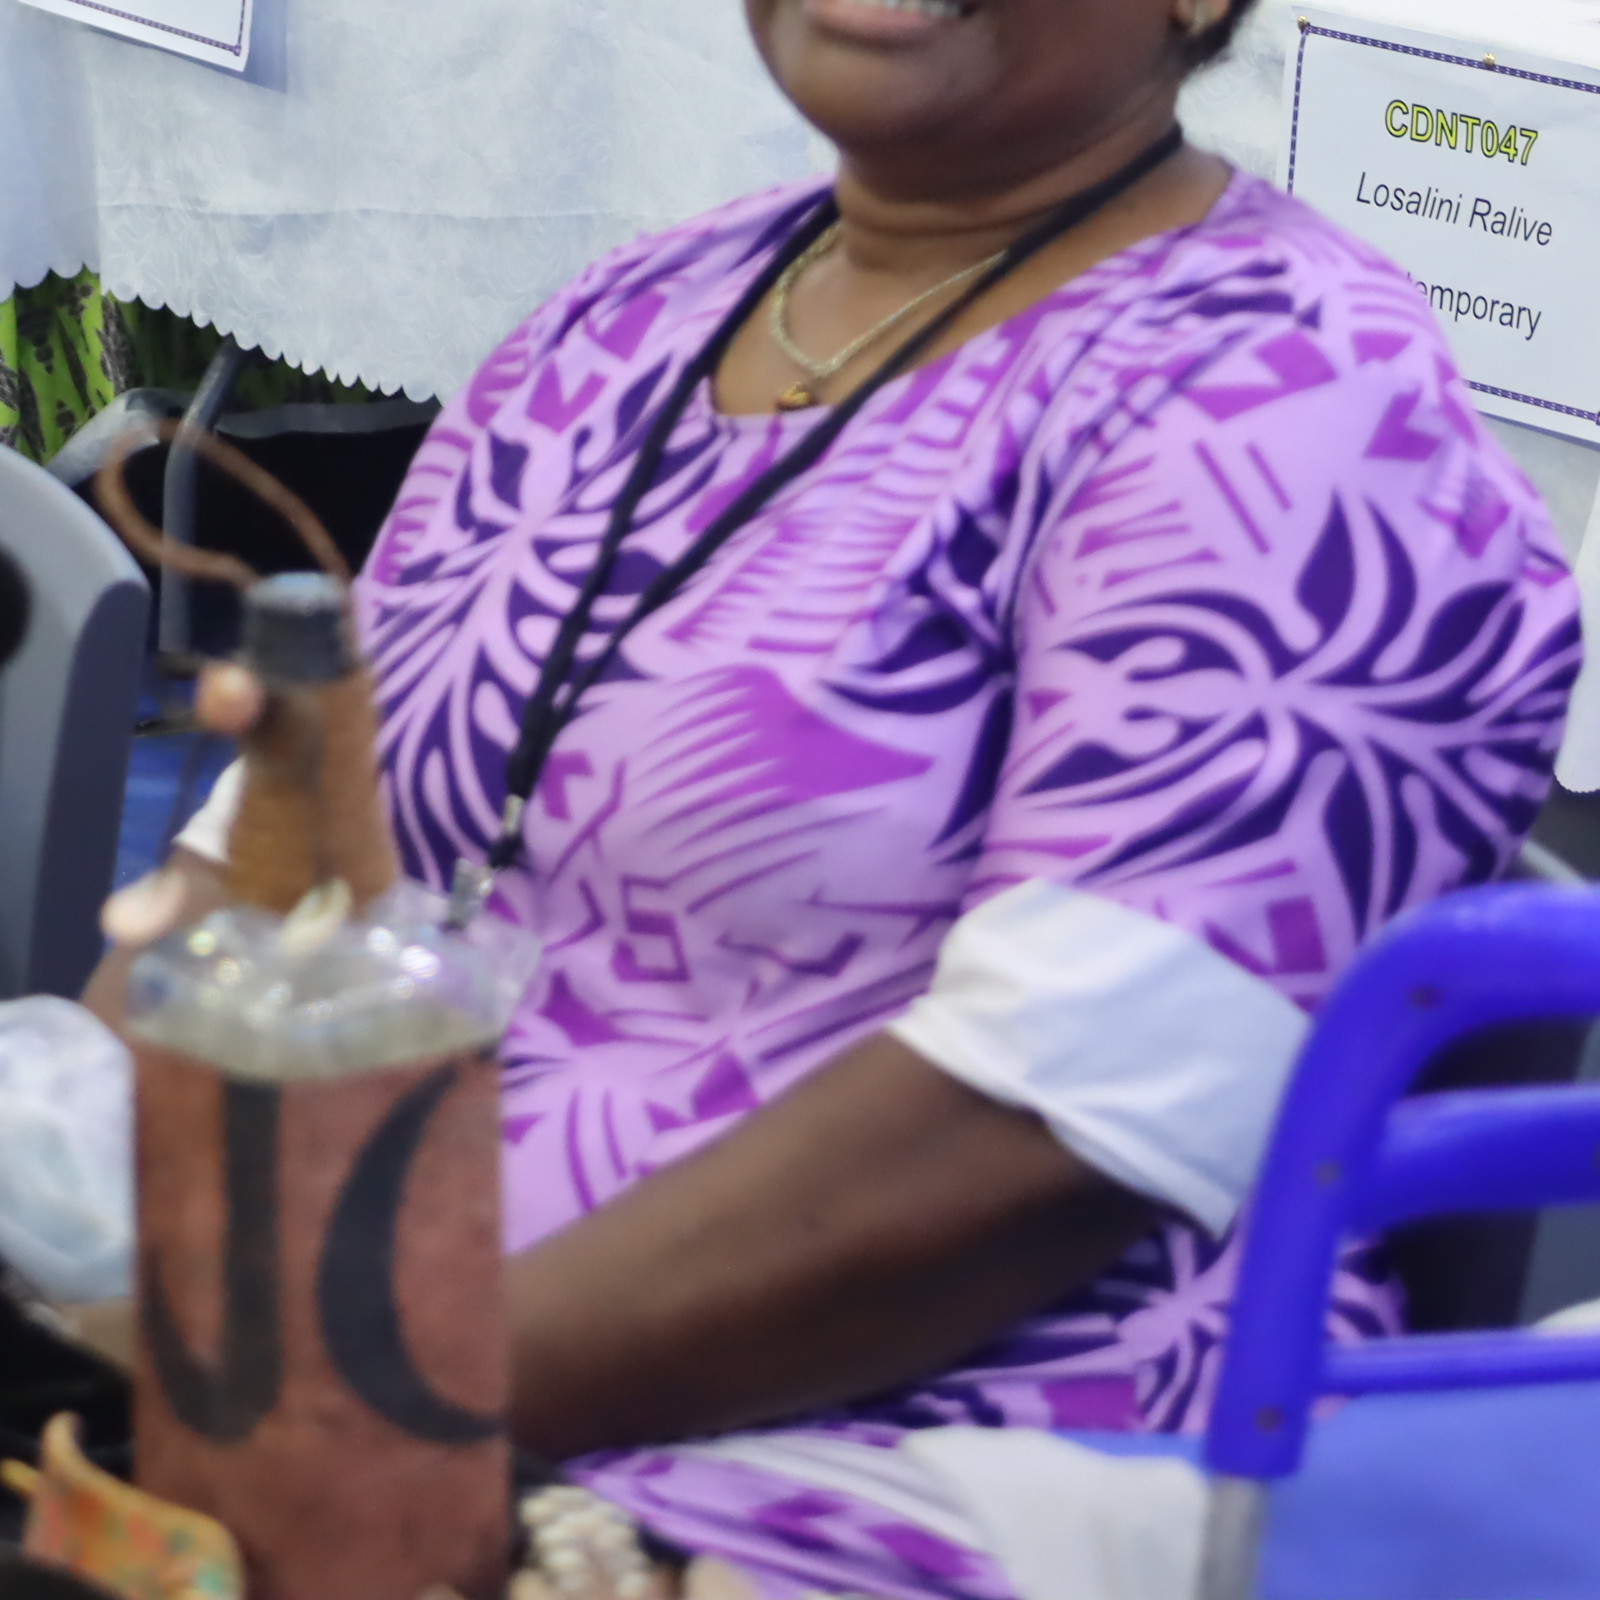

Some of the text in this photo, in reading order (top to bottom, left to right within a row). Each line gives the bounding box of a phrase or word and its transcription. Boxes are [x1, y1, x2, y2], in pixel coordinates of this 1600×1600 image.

[1385, 99, 1539, 167] CDNT047
[1355, 171, 1554, 248] Losalini Ralive
[1406, 270, 1543, 342] emporary
